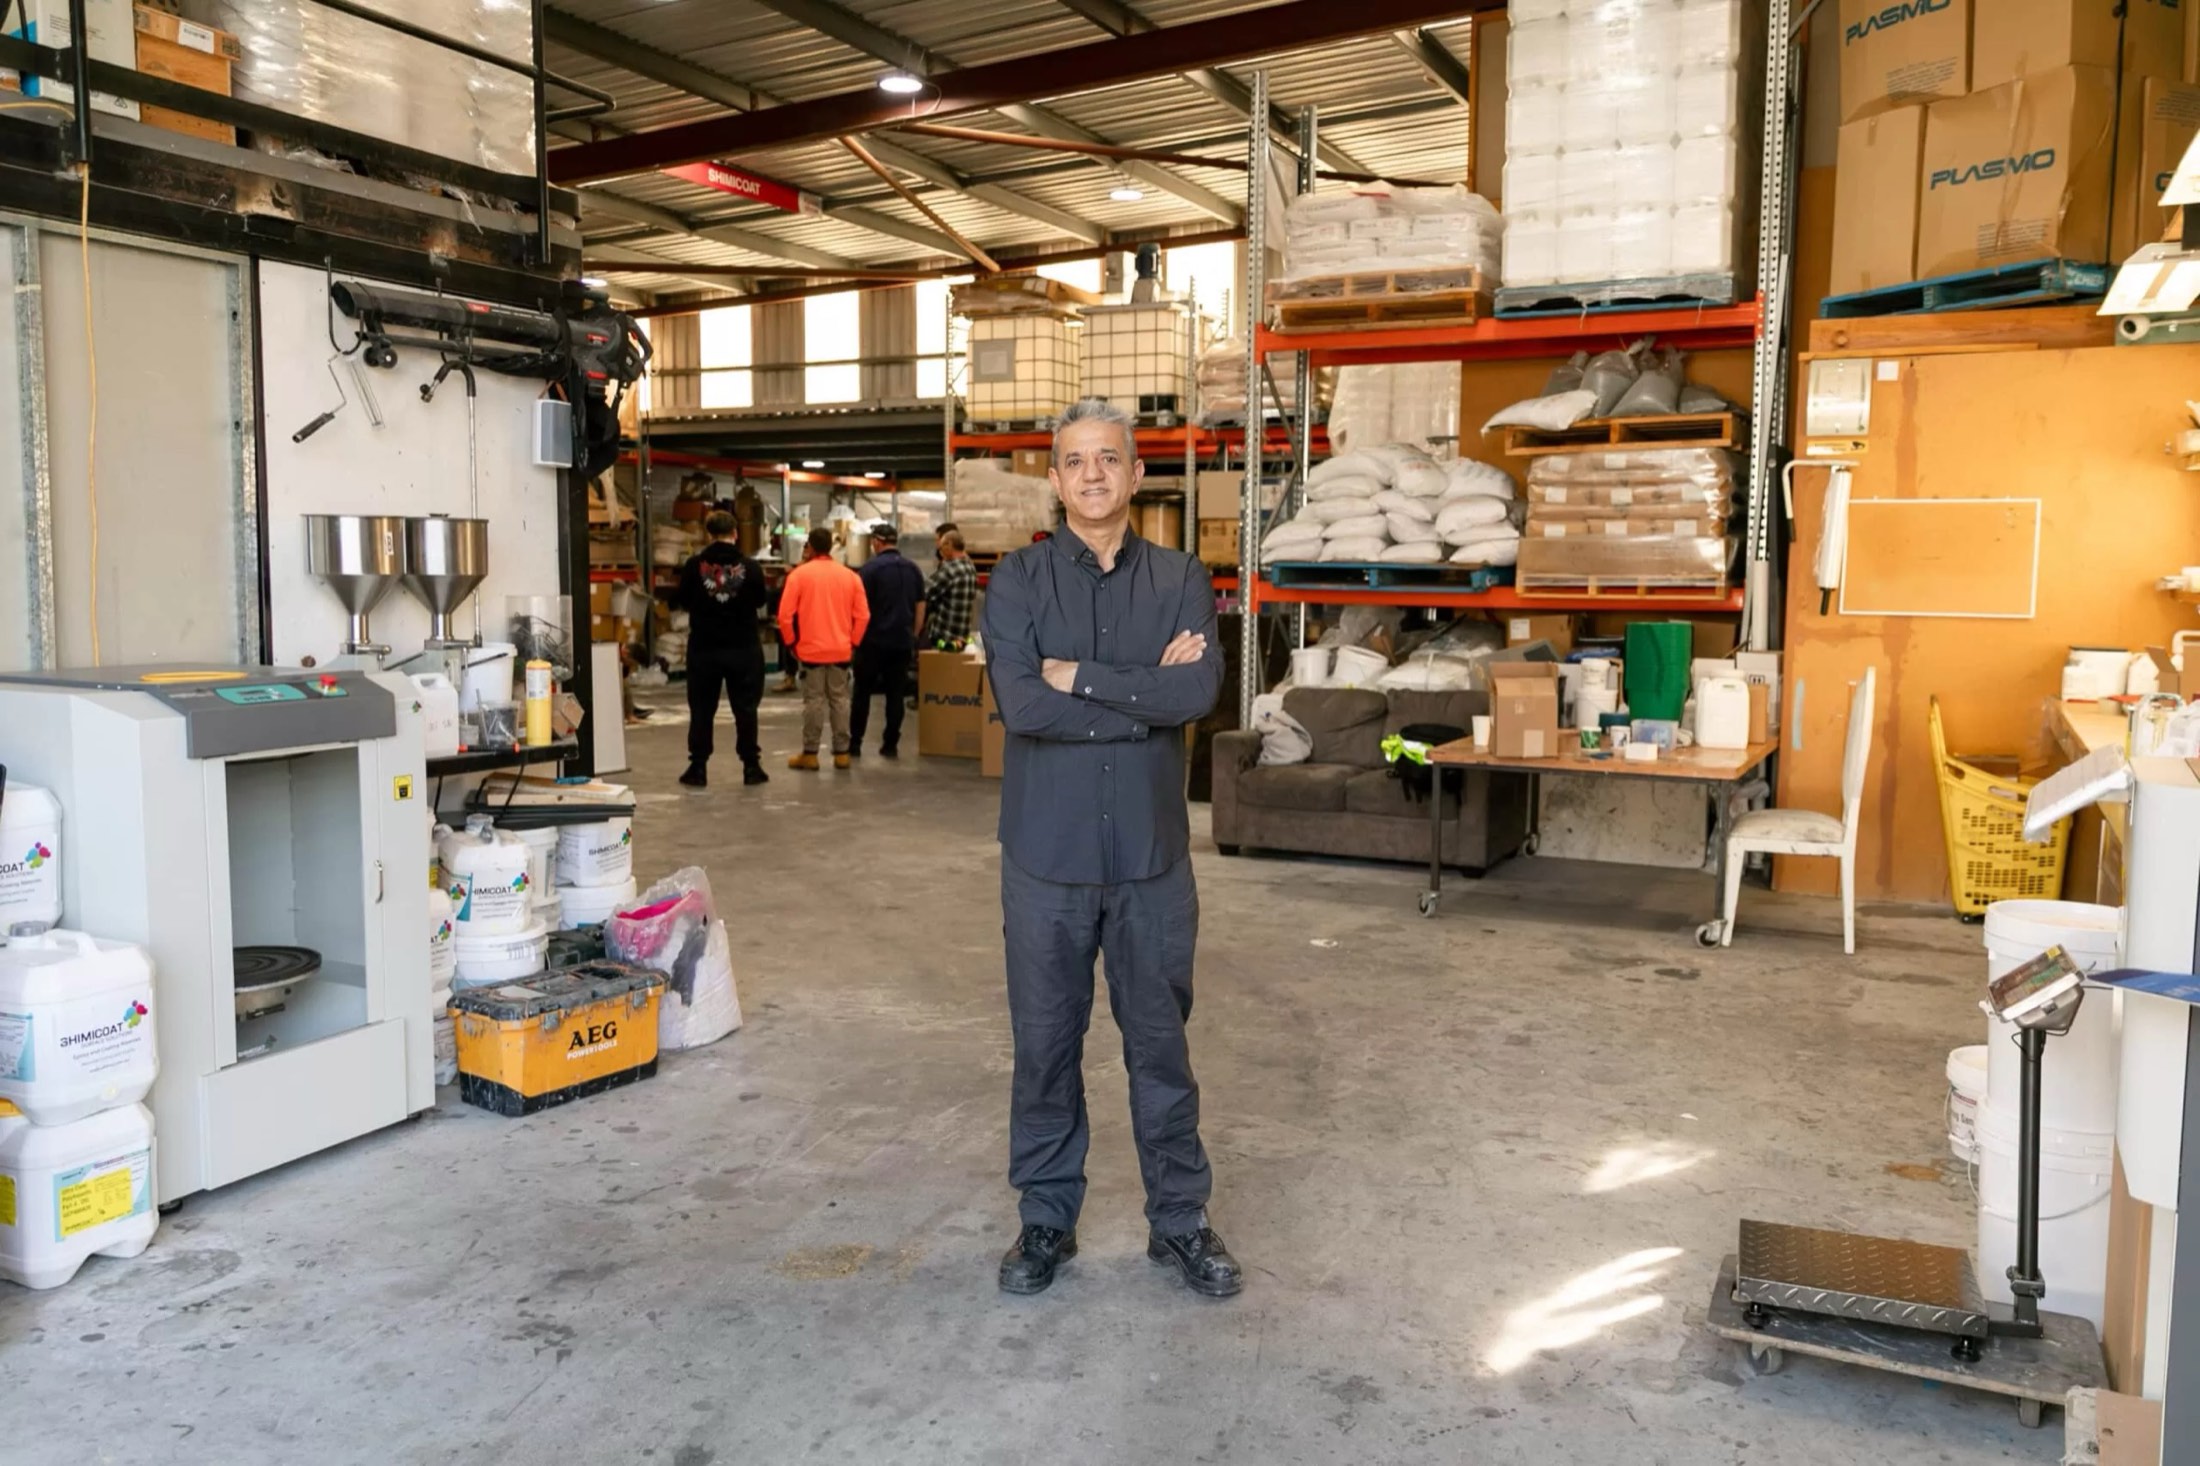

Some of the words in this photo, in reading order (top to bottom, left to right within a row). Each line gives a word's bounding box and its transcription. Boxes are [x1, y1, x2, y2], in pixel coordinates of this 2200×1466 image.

[707, 168, 761, 195] SHIMICOAT
[1930, 147, 2055, 190] PLASMO
[473, 886, 512, 896] HIMICOAT
[60, 1022, 123, 1047] SHIMICOAT
[568, 1021, 617, 1050] AEG
[566, 1040, 618, 1061] POWERTOOLS
